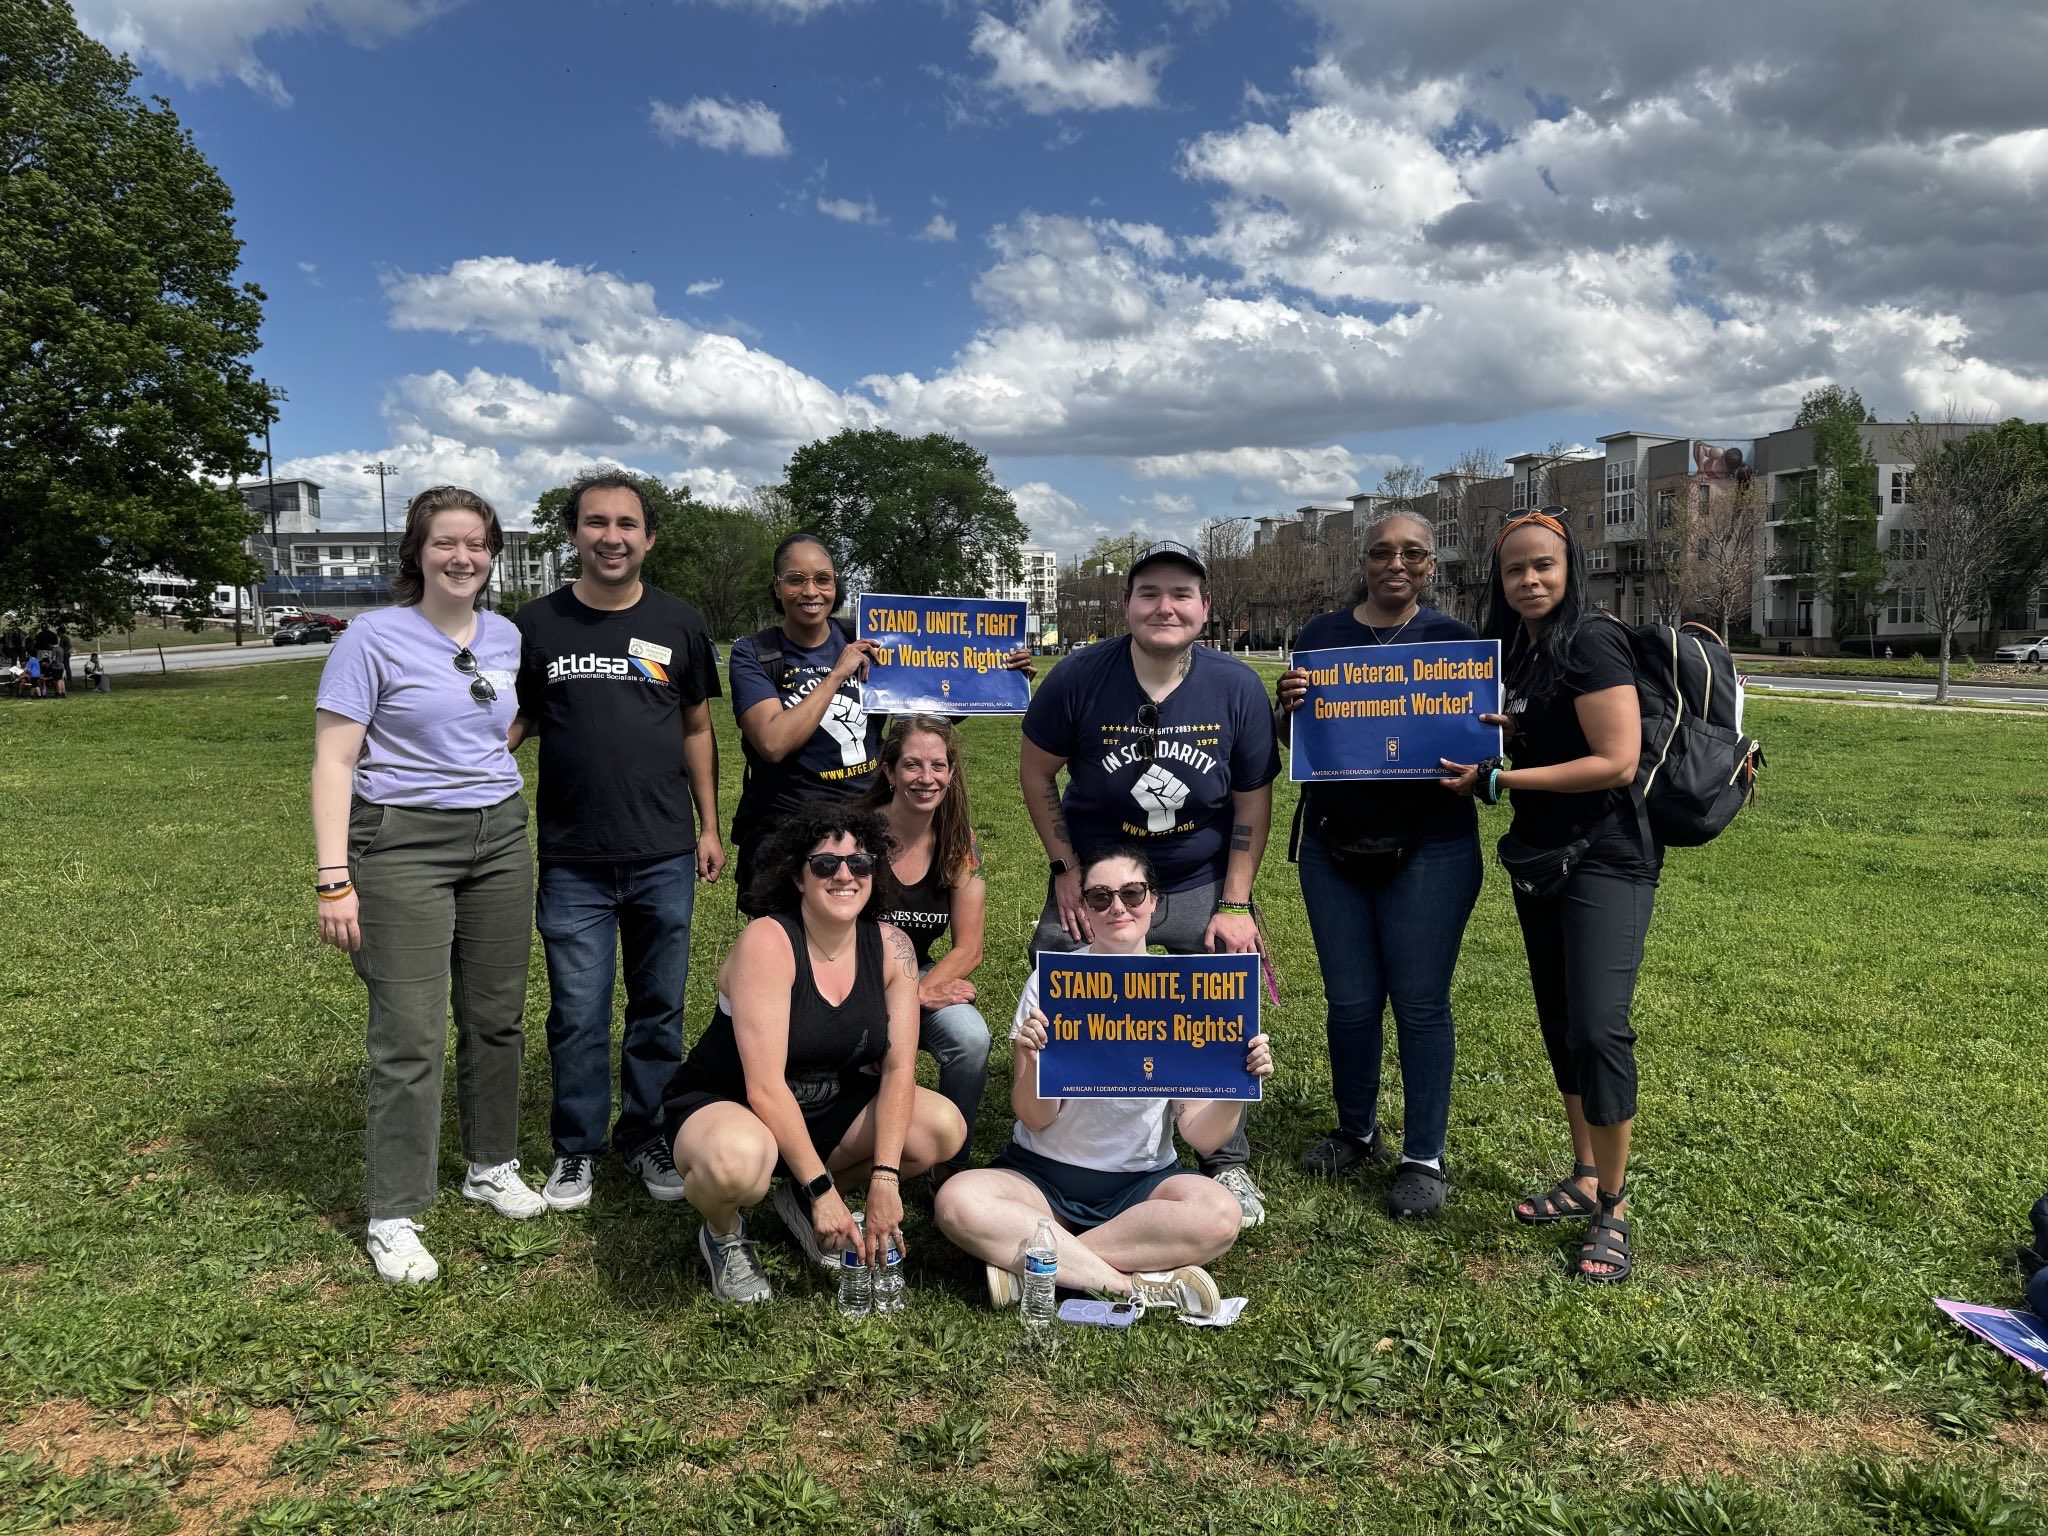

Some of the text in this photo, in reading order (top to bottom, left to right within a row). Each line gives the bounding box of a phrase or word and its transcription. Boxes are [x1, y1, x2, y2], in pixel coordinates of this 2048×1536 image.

[868, 608, 1018, 639] STAND, UNITE, FIGHT
[546, 653, 629, 679] atldsa
[876, 647, 894, 666] or
[898, 644, 960, 669] Workers
[567, 672, 605, 680] Democratic
[606, 674, 638, 682] Socialists
[1297, 656, 1494, 687] roud Veteran, Dedicated
[1315, 691, 1474, 720] Government Worker!
[1103, 738, 1219, 747] EST. 1972
[1130, 725, 1147, 735] AFGE
[819, 757, 878, 780] WWW.AFGE.OR
[1101, 740, 1217, 775] IN SODARITY
[890, 921, 934, 929] OLLEGE
[912, 911, 949, 924] SCOTT
[1049, 970, 1118, 1003] STAND,
[1124, 972, 1186, 1003] UNITE,
[1192, 971, 1248, 1000] FIGHT
[1053, 1013, 1244, 1048] for Workers Rights!
[1179, 1086, 1214, 1094] EMPLOYEES,
